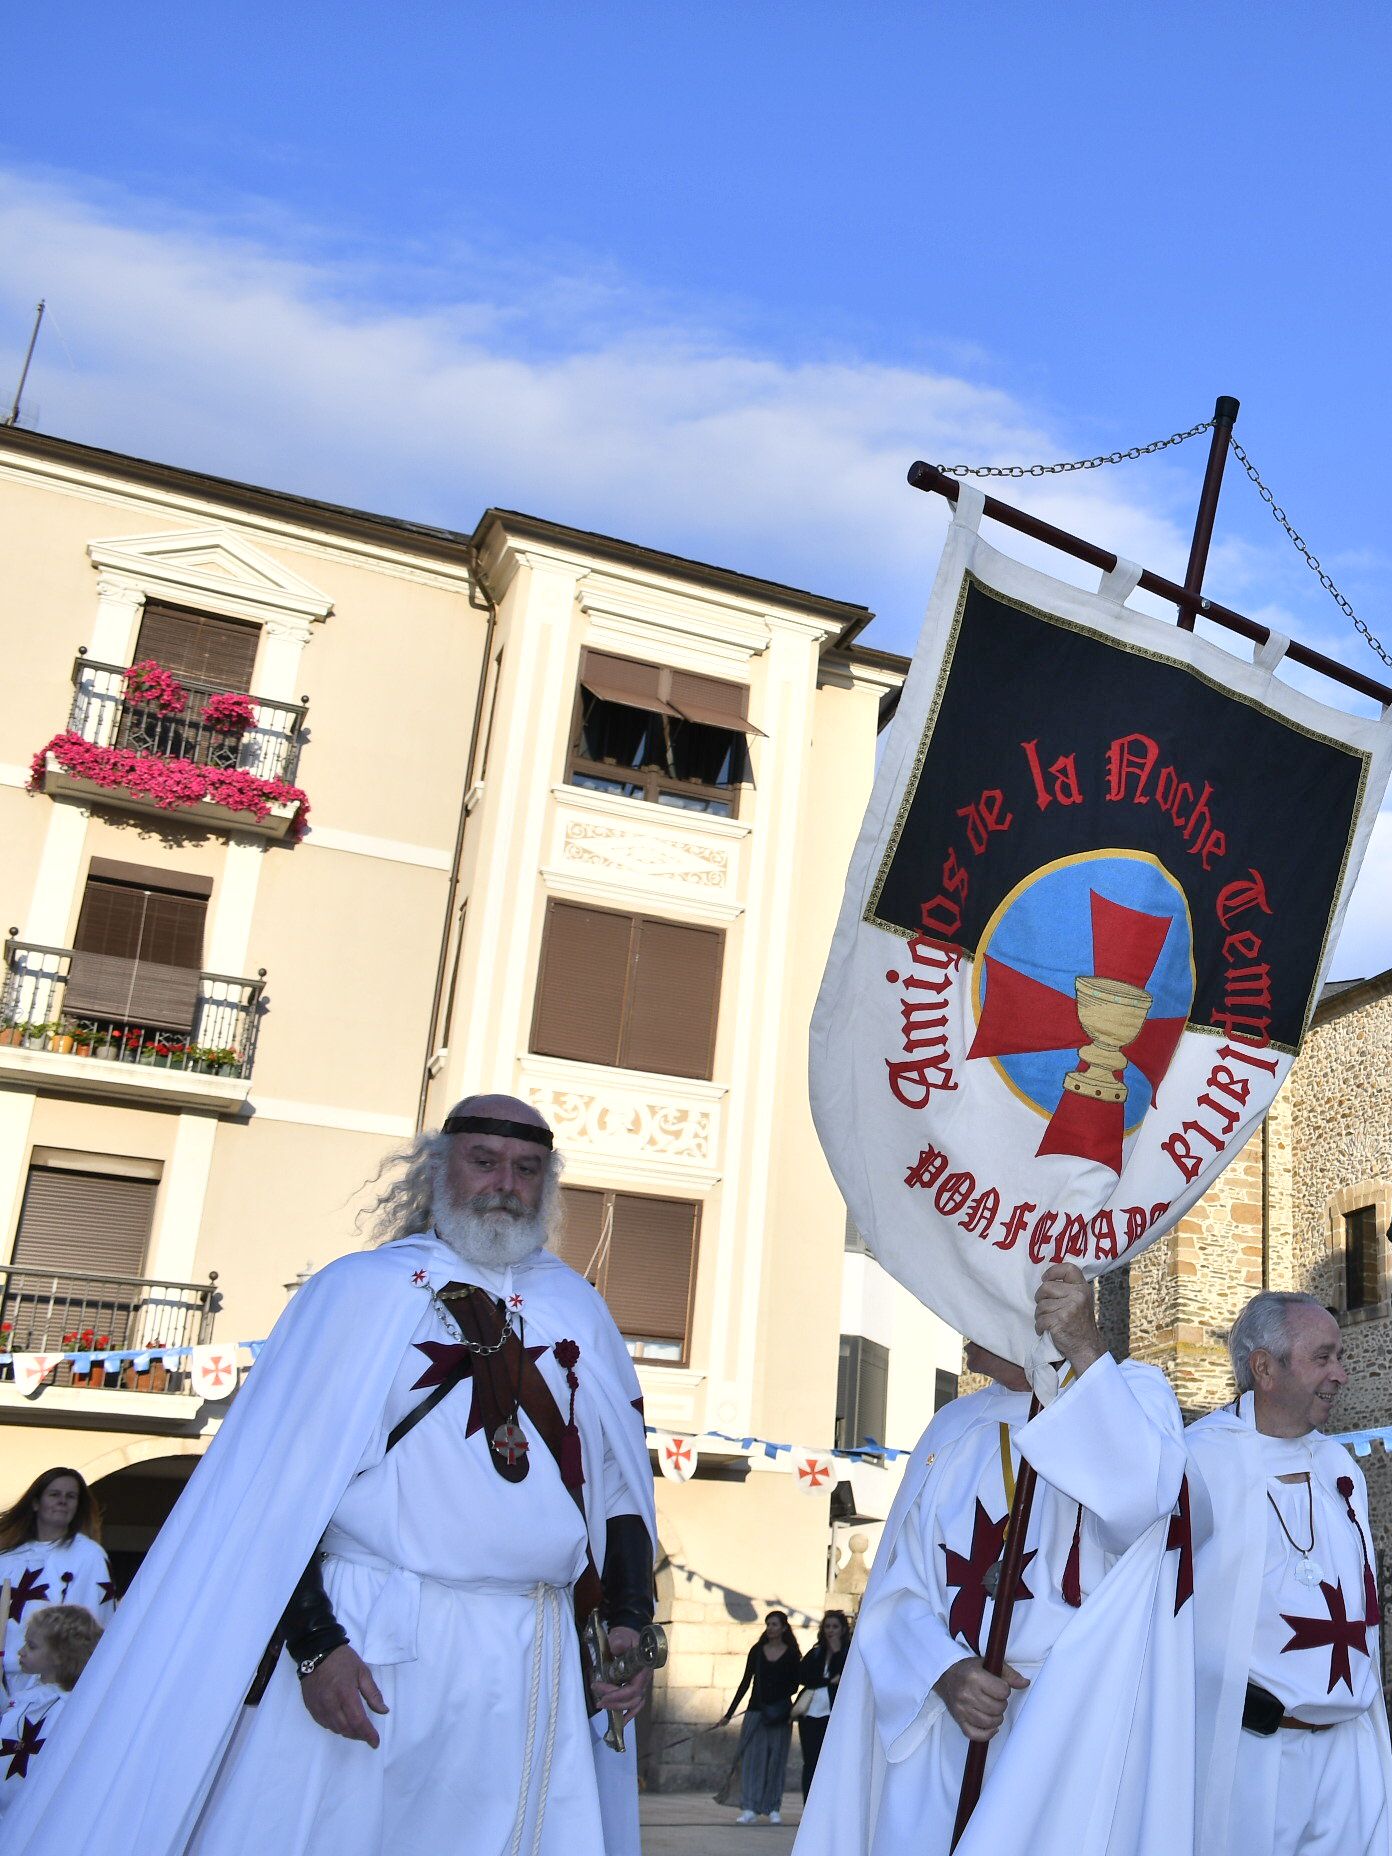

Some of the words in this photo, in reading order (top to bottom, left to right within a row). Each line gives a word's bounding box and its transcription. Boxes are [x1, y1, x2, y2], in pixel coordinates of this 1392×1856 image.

[957, 788, 1014, 856] de
[1020, 737, 1085, 812] la
[1105, 732, 1229, 871] Noche
[885, 847, 970, 1109] Amigos
[1161, 867, 1279, 1185] Templaria
